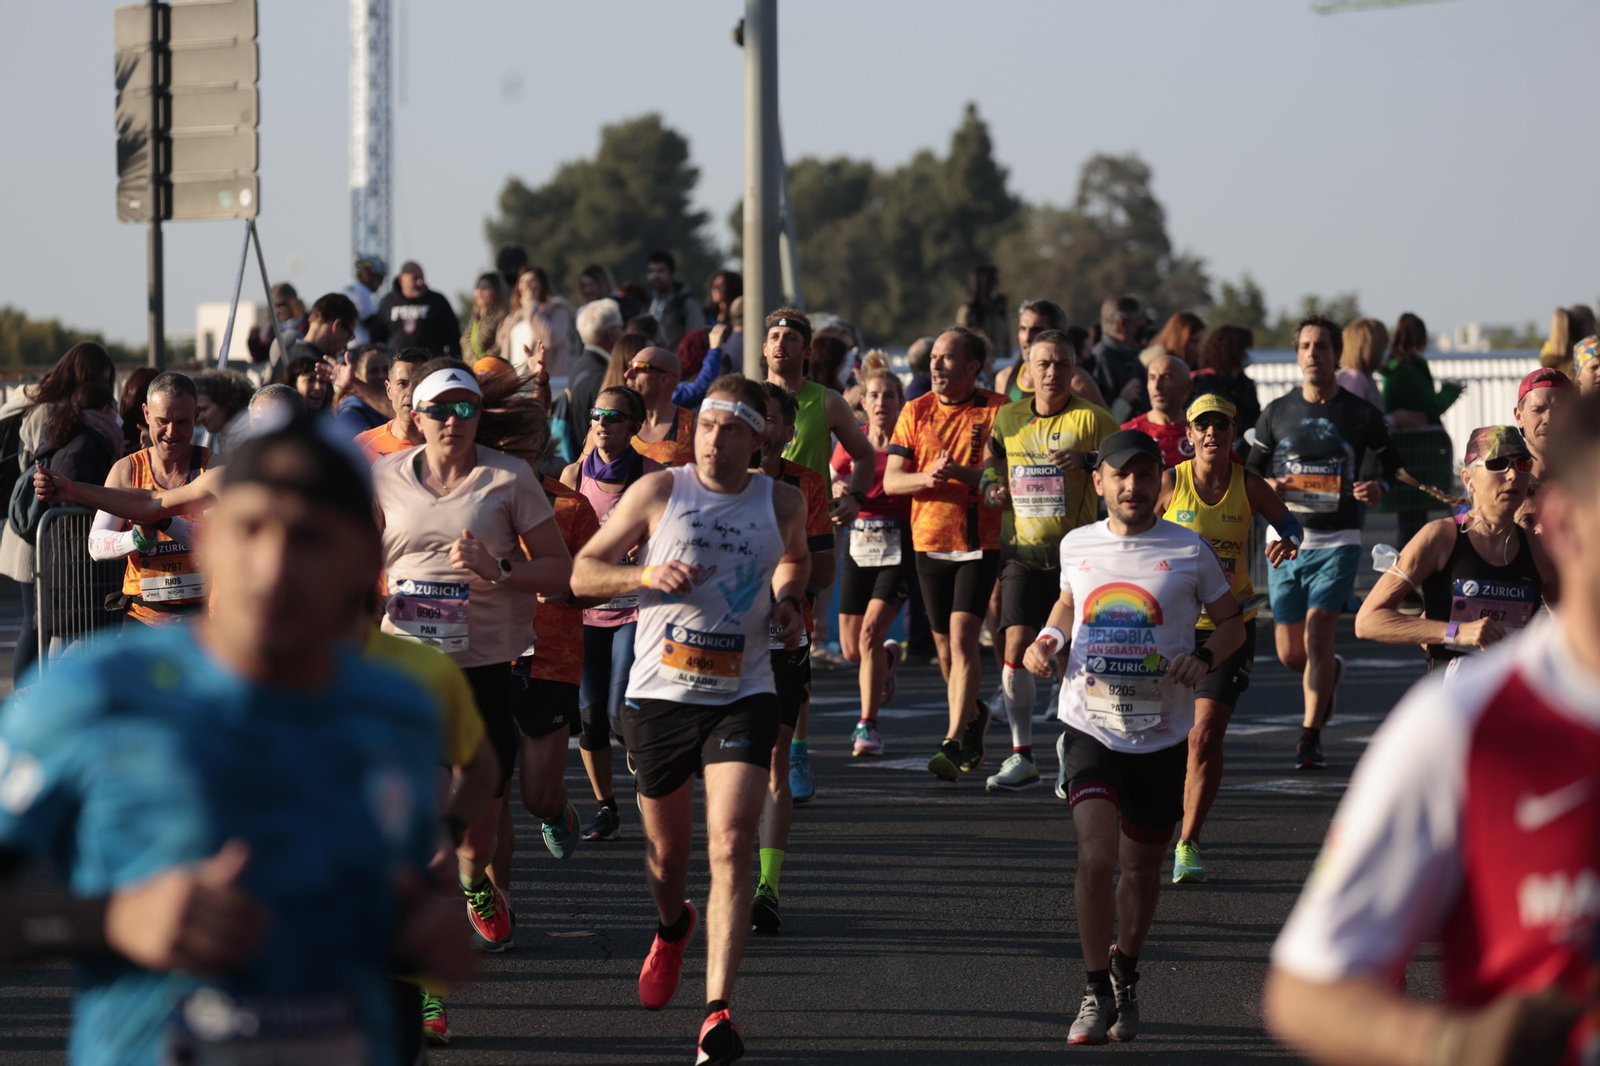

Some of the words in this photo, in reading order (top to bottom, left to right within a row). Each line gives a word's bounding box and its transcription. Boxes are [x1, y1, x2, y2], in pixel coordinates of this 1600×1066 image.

[1025, 467, 1056, 475] ZURICH
[1303, 465, 1334, 474] ZURICH
[1026, 484, 1044, 492] 6795
[1031, 496, 1063, 504] QUEIROGA
[158, 543, 190, 553] ZURIC
[161, 562, 182, 572] 3797
[165, 577, 182, 586] RIOS
[416, 584, 460, 597] ZURICH
[1482, 585, 1525, 598] ZURICH
[416, 607, 441, 619] 6909
[1481, 609, 1507, 622] 6057
[420, 625, 437, 635] PAN
[1088, 627, 1156, 645] BEHOBIA
[688, 633, 735, 648] ZURICH
[1087, 645, 1104, 655] SAN
[1104, 644, 1158, 656] SEBASTIÁN
[685, 656, 715, 671] 4909
[1109, 661, 1154, 673] ZURIC
[1108, 685, 1136, 697] 9205
[1110, 703, 1133, 713] PATXI
